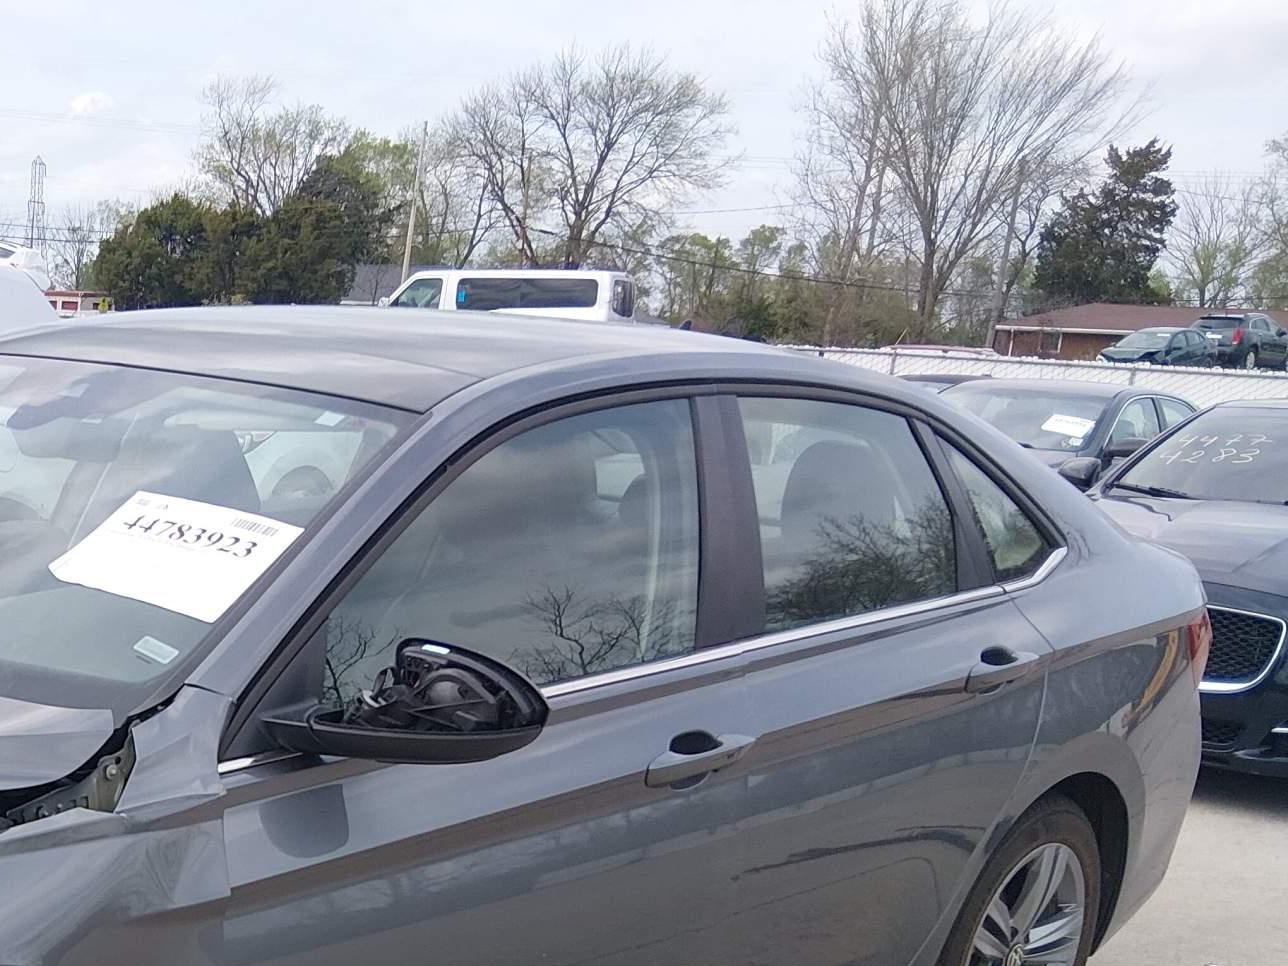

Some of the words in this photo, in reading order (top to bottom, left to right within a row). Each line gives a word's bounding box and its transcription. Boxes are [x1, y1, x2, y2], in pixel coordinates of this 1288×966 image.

[1179, 434, 1273, 449] 4477
[1159, 448, 1261, 465] 4283
[123, 515, 258, 558] 44783923
